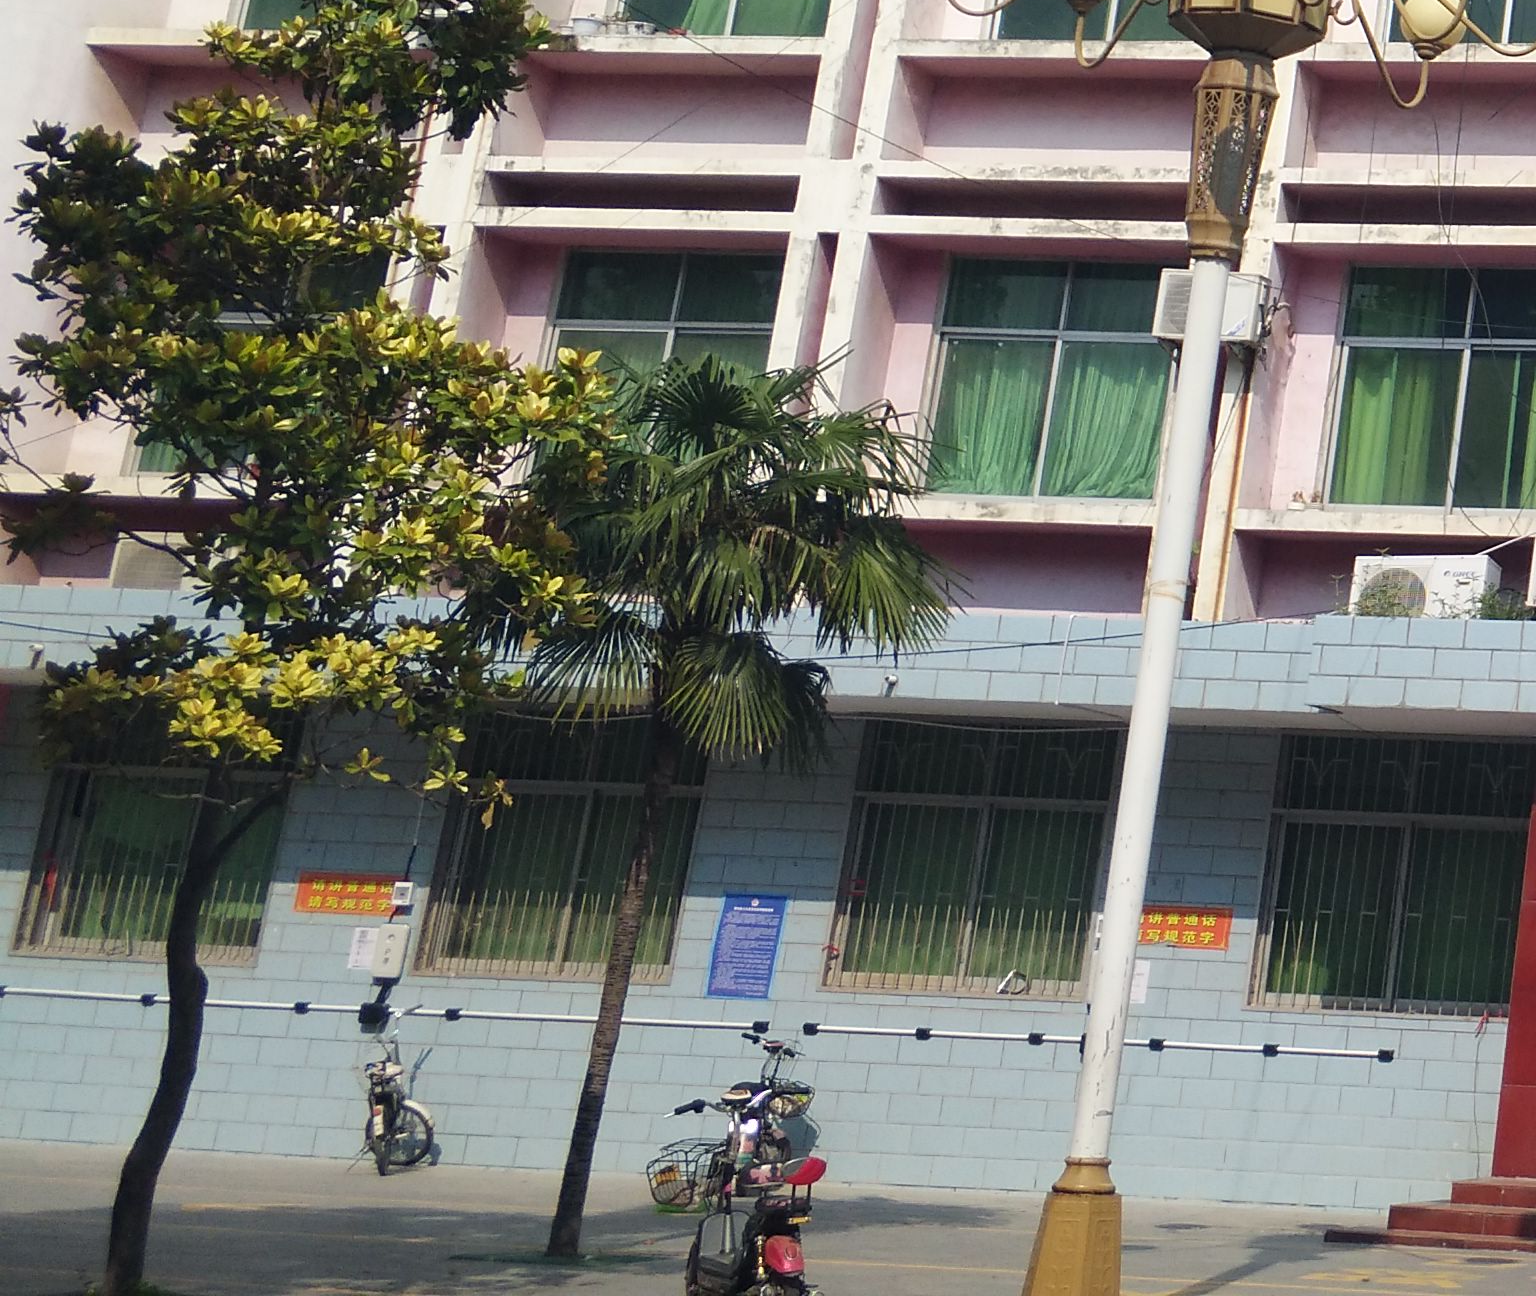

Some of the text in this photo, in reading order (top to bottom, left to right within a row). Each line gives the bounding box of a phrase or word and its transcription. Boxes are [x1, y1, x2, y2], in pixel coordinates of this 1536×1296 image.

[313, 880, 394, 893] 请讲普通话
[308, 896, 392, 912] 请写规范字
[1140, 912, 1217, 927] 讲普通话
[1138, 929, 1215, 944] 写规范字
